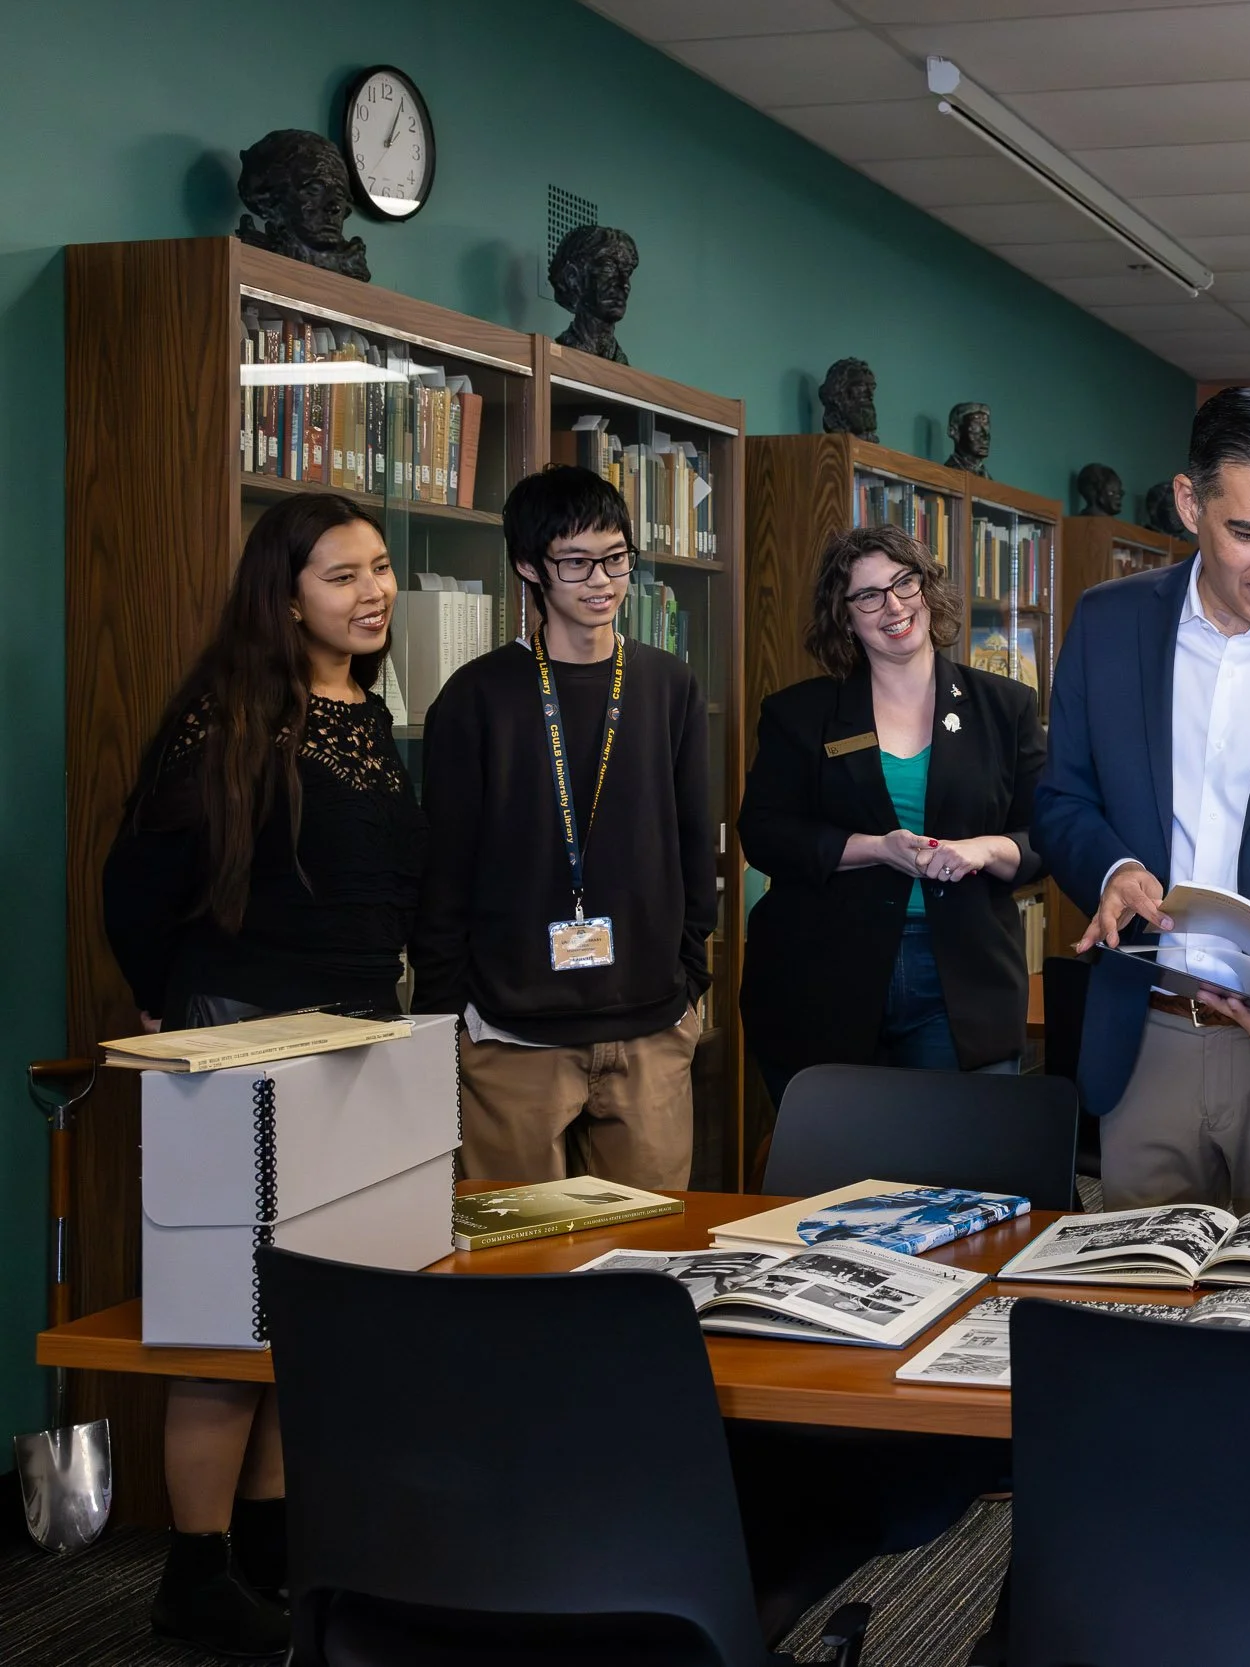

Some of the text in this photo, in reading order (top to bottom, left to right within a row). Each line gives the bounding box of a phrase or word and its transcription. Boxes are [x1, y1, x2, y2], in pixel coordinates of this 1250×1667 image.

[368, 85, 376, 103] 11
[381, 82, 393, 101] 12
[356, 103, 369, 122] 10
[408, 116, 416, 133] 2
[352, 127, 360, 143] 9
[412, 144, 420, 161] 3
[356, 153, 365, 171] 8
[367, 176, 376, 193] 7
[407, 170, 415, 185] 4
[381, 186, 391, 198] 6
[397, 184, 405, 200] 5
[540, 662, 551, 695] Library
[612, 669, 623, 700] CSULB
[603, 727, 615, 761] Library
[550, 724, 574, 844] CSULB University Library
[583, 1217, 608, 1226] CALIFORNIA
[481, 1229, 541, 1245] COMMENCEMENTS
